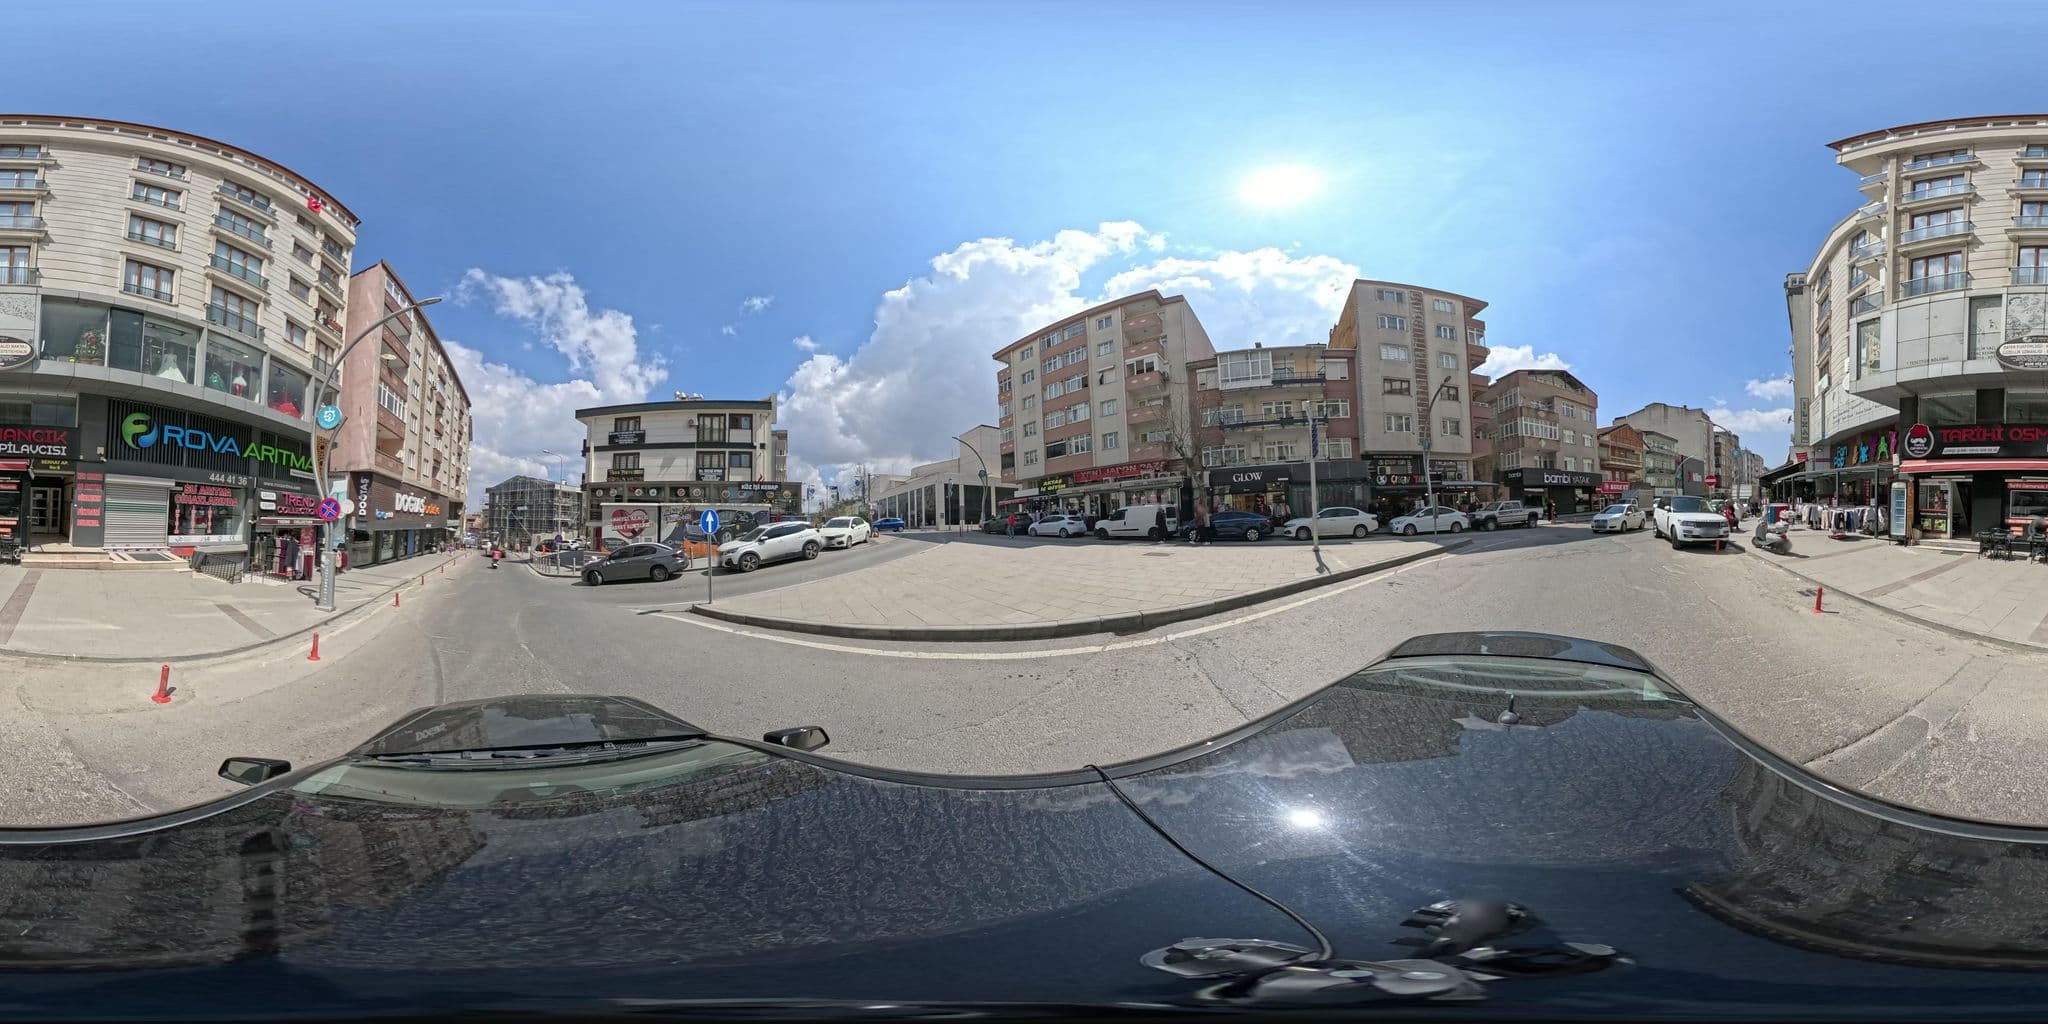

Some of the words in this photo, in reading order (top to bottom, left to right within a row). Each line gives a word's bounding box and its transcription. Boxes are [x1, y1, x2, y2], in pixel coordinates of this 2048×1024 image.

[0, 428, 69, 445] ANCIK
[0, 441, 67, 456] PİLAVCISI
[163, 424, 241, 457] ROVA
[243, 442, 315, 471] ARITMA
[209, 472, 225, 484] 444
[226, 474, 236, 485] 41
[238, 476, 248, 486] 36
[1232, 471, 1263, 483] GLOW
[1543, 471, 1571, 484] bambi
[1571, 476, 1591, 484] YATAK
[281, 491, 316, 508] TREND
